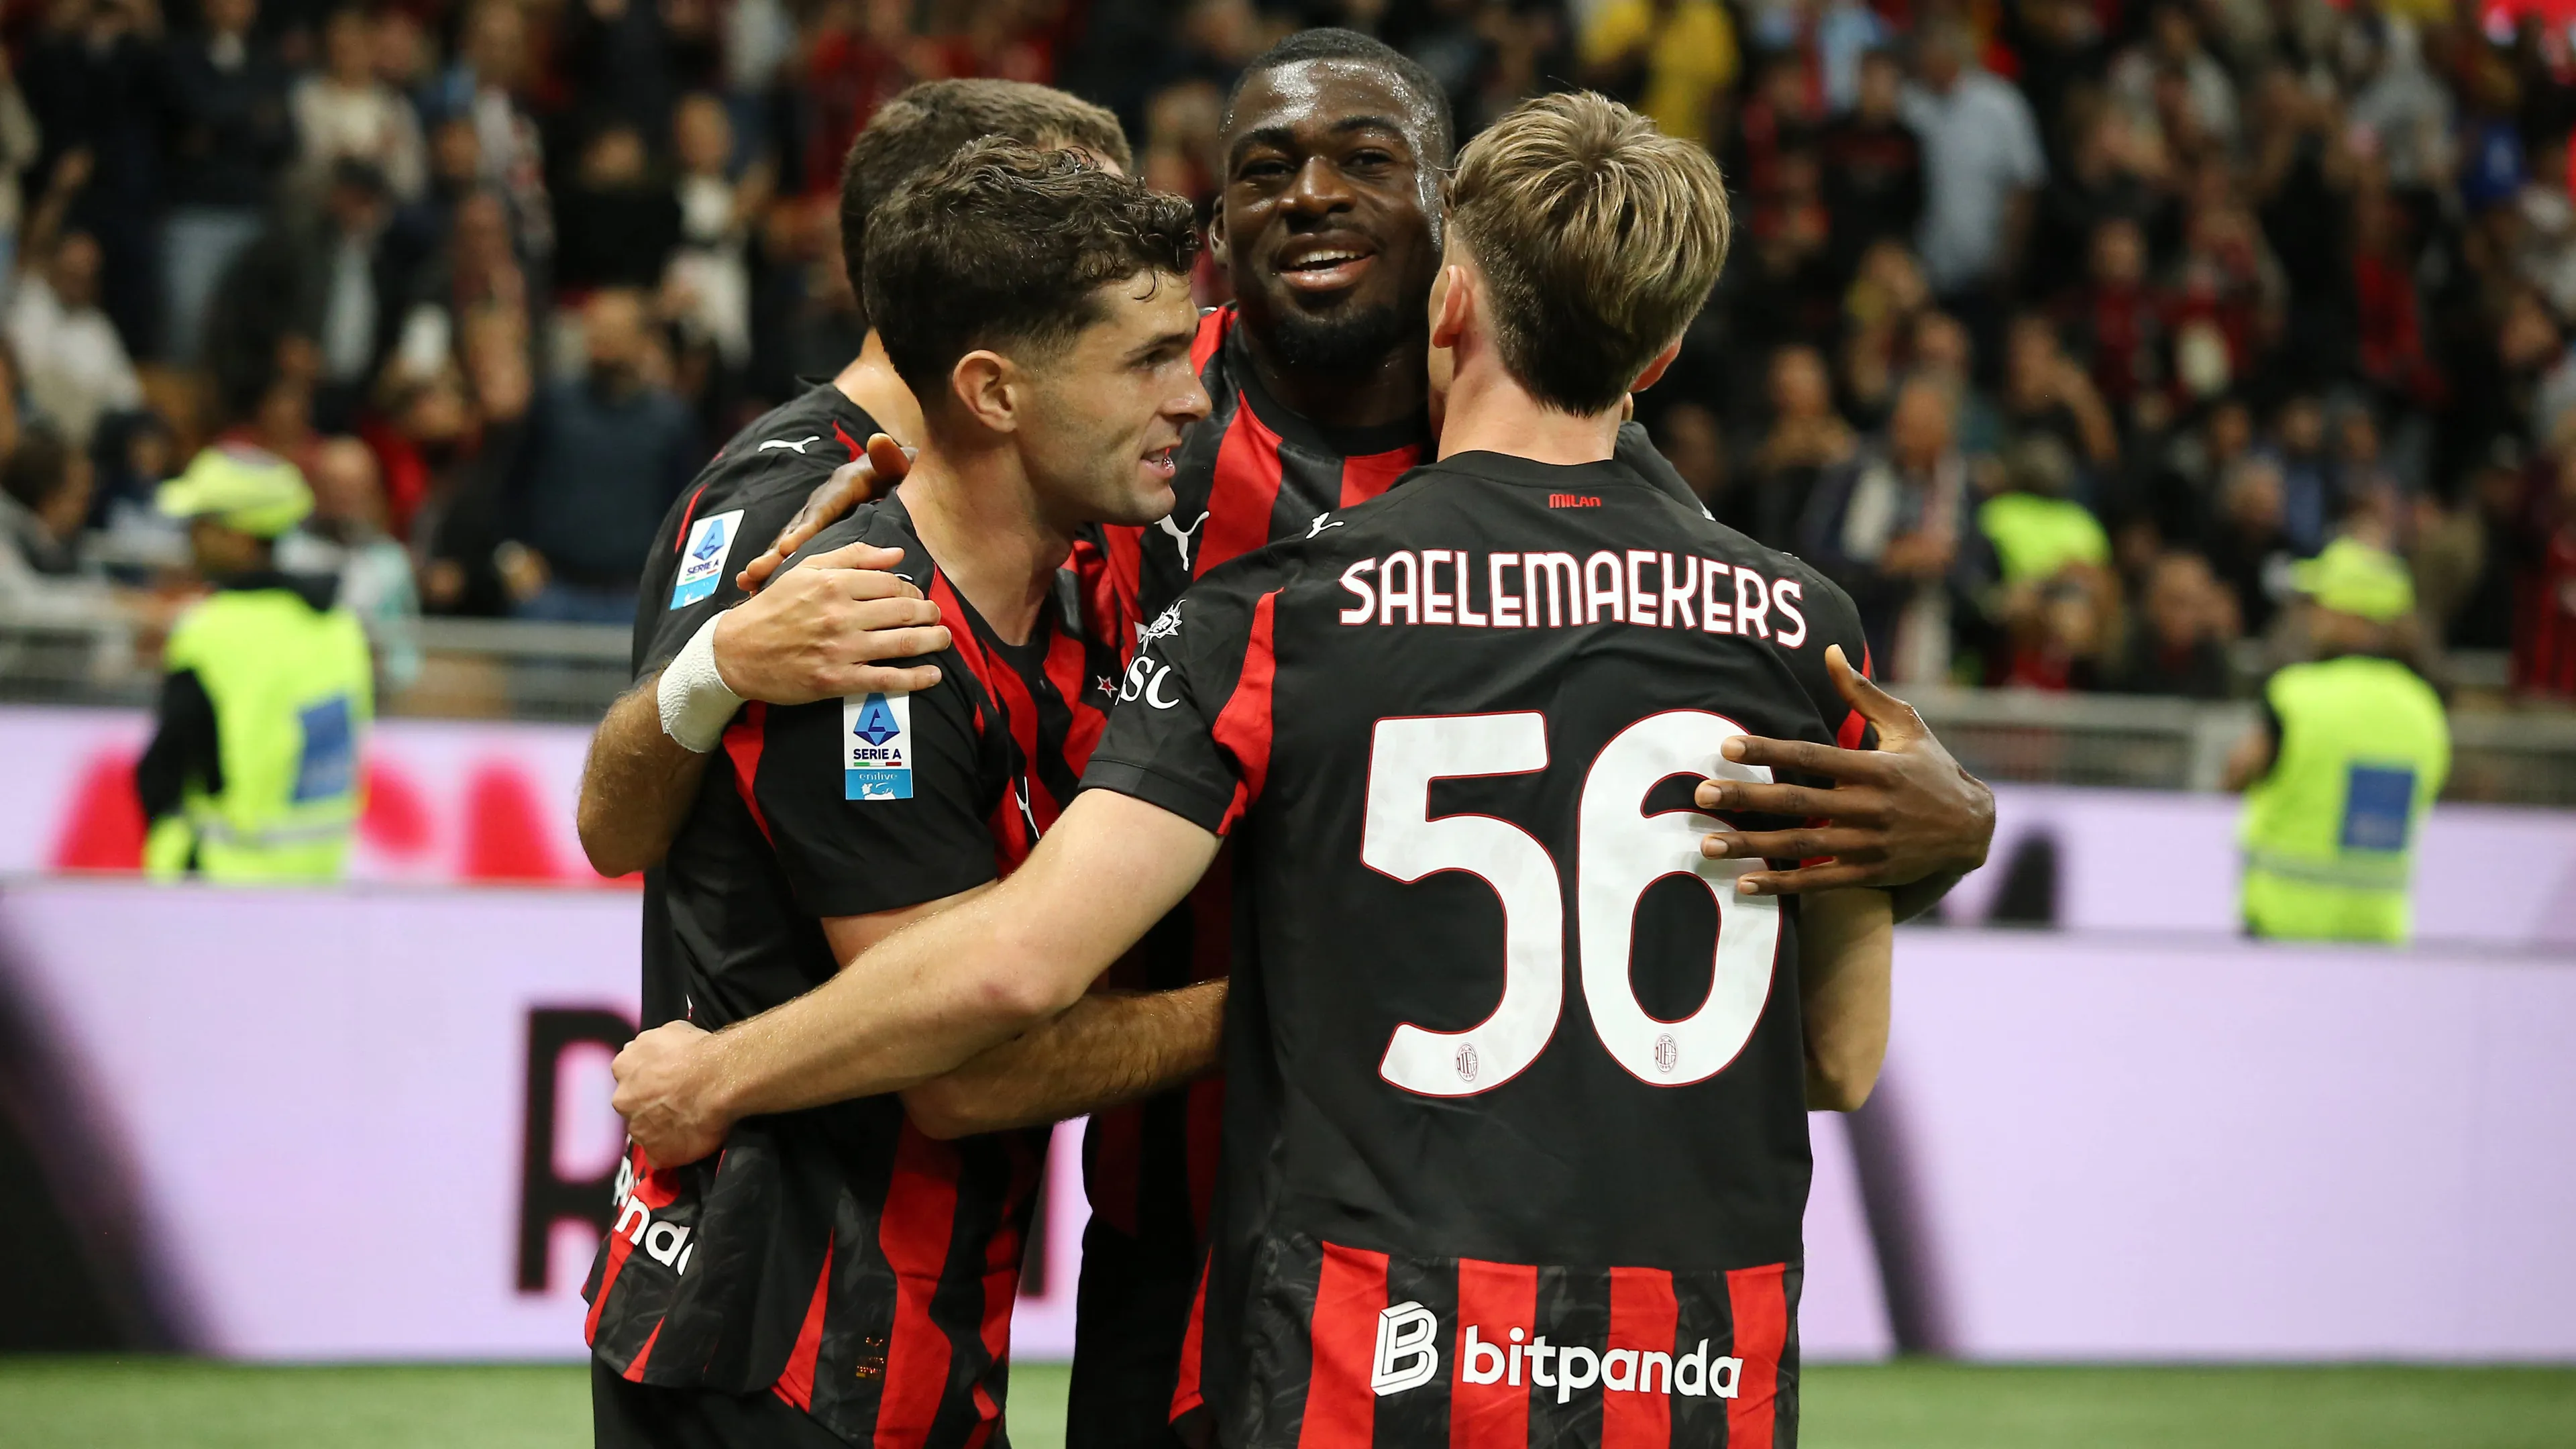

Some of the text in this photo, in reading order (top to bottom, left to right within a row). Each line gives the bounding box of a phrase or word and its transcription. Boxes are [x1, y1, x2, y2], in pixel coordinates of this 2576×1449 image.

[1549, 494, 1601, 508] MILAN
[686, 558, 719, 576] SERIE A
[1338, 549, 1808, 649] SAELEMAEKERS
[1115, 655, 1179, 710] SC
[853, 748, 902, 759] SERIE A
[859, 772, 898, 780] enilive
[1360, 708, 1782, 1097] 56
[1462, 1325, 1743, 1404] bitpanda
